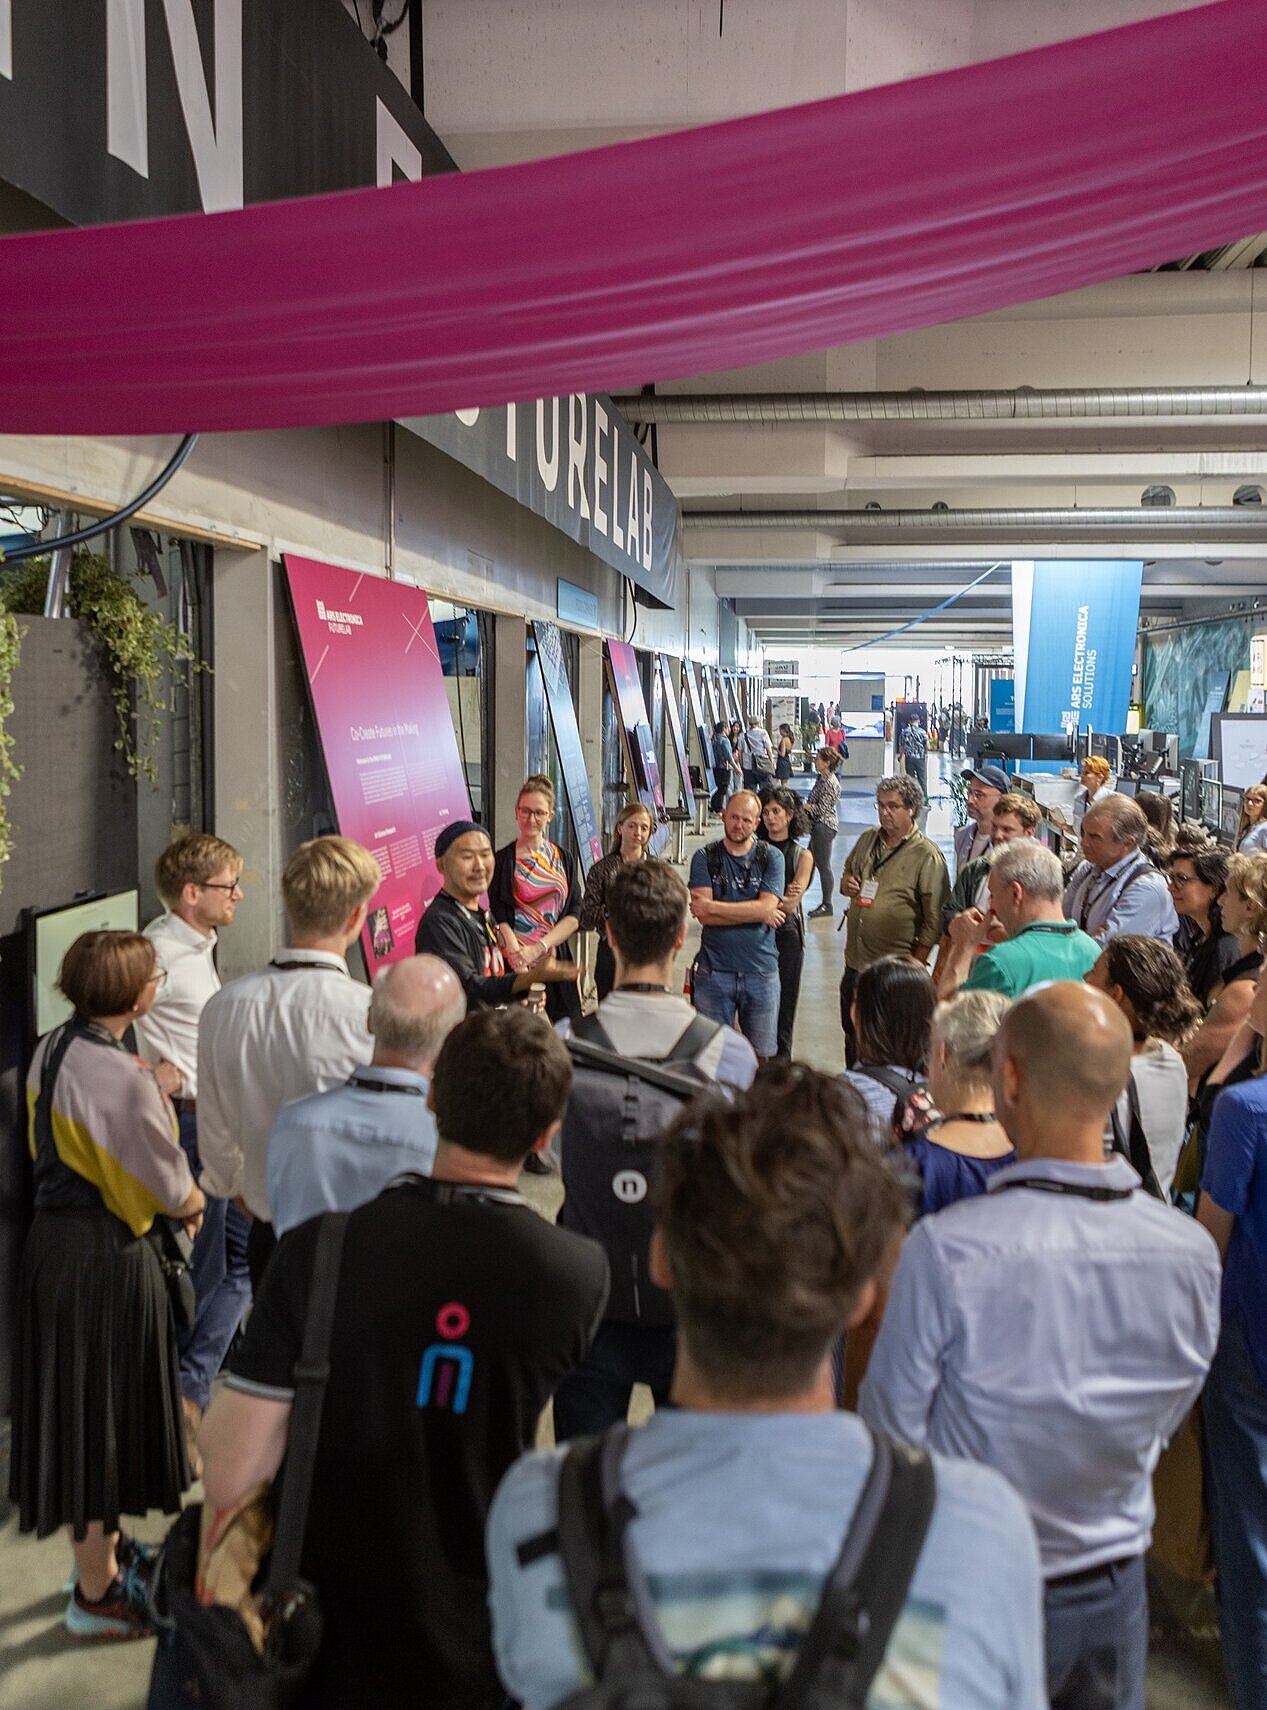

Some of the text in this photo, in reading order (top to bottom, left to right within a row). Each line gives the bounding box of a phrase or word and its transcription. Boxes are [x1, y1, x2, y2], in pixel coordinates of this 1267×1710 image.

[335, 611, 363, 626] ELECTRONICA
[328, 621, 352, 635] FUTURELAB
[1071, 605, 1089, 709] ARS ELECTRONICA
[1083, 649, 1097, 709] SOLUTIONS
[622, 1179, 637, 1195] n
